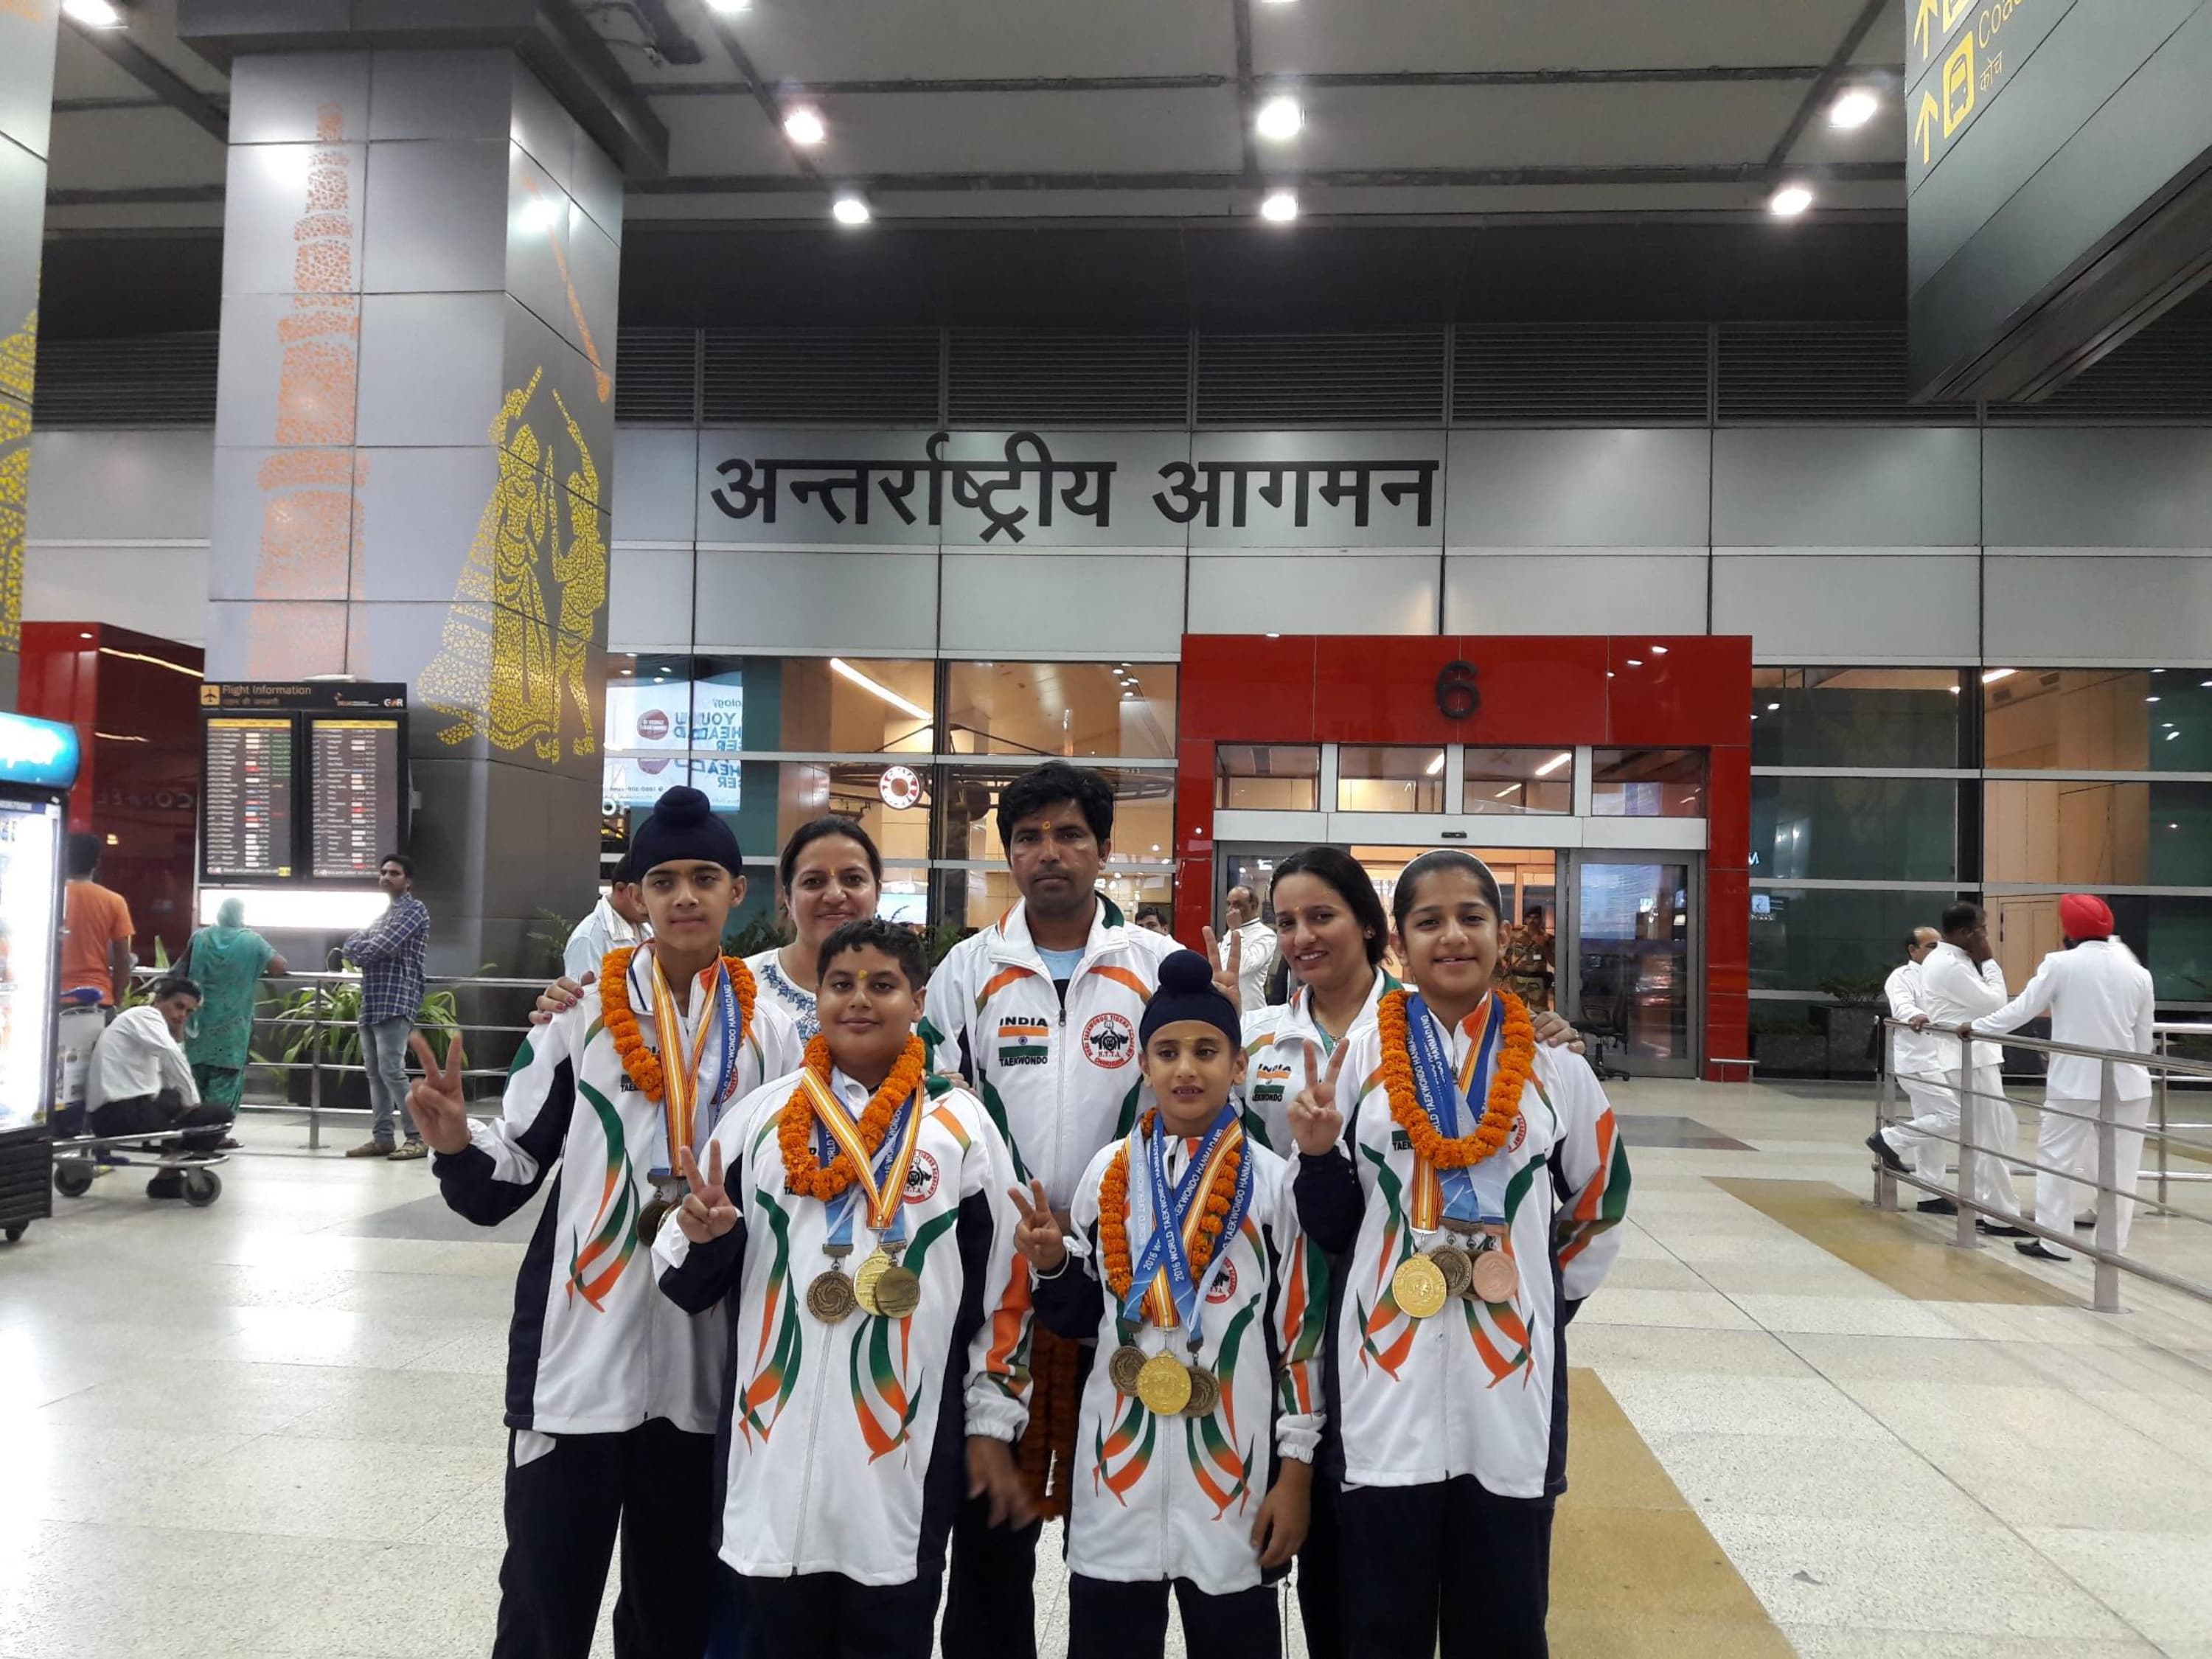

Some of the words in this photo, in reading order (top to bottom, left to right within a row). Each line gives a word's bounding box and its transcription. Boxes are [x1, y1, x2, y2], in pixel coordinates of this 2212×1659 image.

[1979, 50, 2003, 92] कोच
[710, 431, 1117, 543] अन्तर्राष्ट्रीय
[1152, 458, 1439, 528] आगमन
[223, 684, 249, 697] Flight
[252, 684, 312, 695] Information
[1436, 660, 1480, 720] 6
[1000, 1017, 1048, 1026] INDIA
[999, 1056, 1048, 1067] TAEKWONDO
[1258, 1063, 1291, 1072] INDIA
[1415, 1065, 1436, 1113] TAEKWONDO
[1224, 1189, 1245, 1242] TAEKWONDO
[1166, 1231, 1179, 1262] WORLD
[1144, 1251, 1158, 1271] 2016
[1171, 1262, 1185, 1281] 2016
